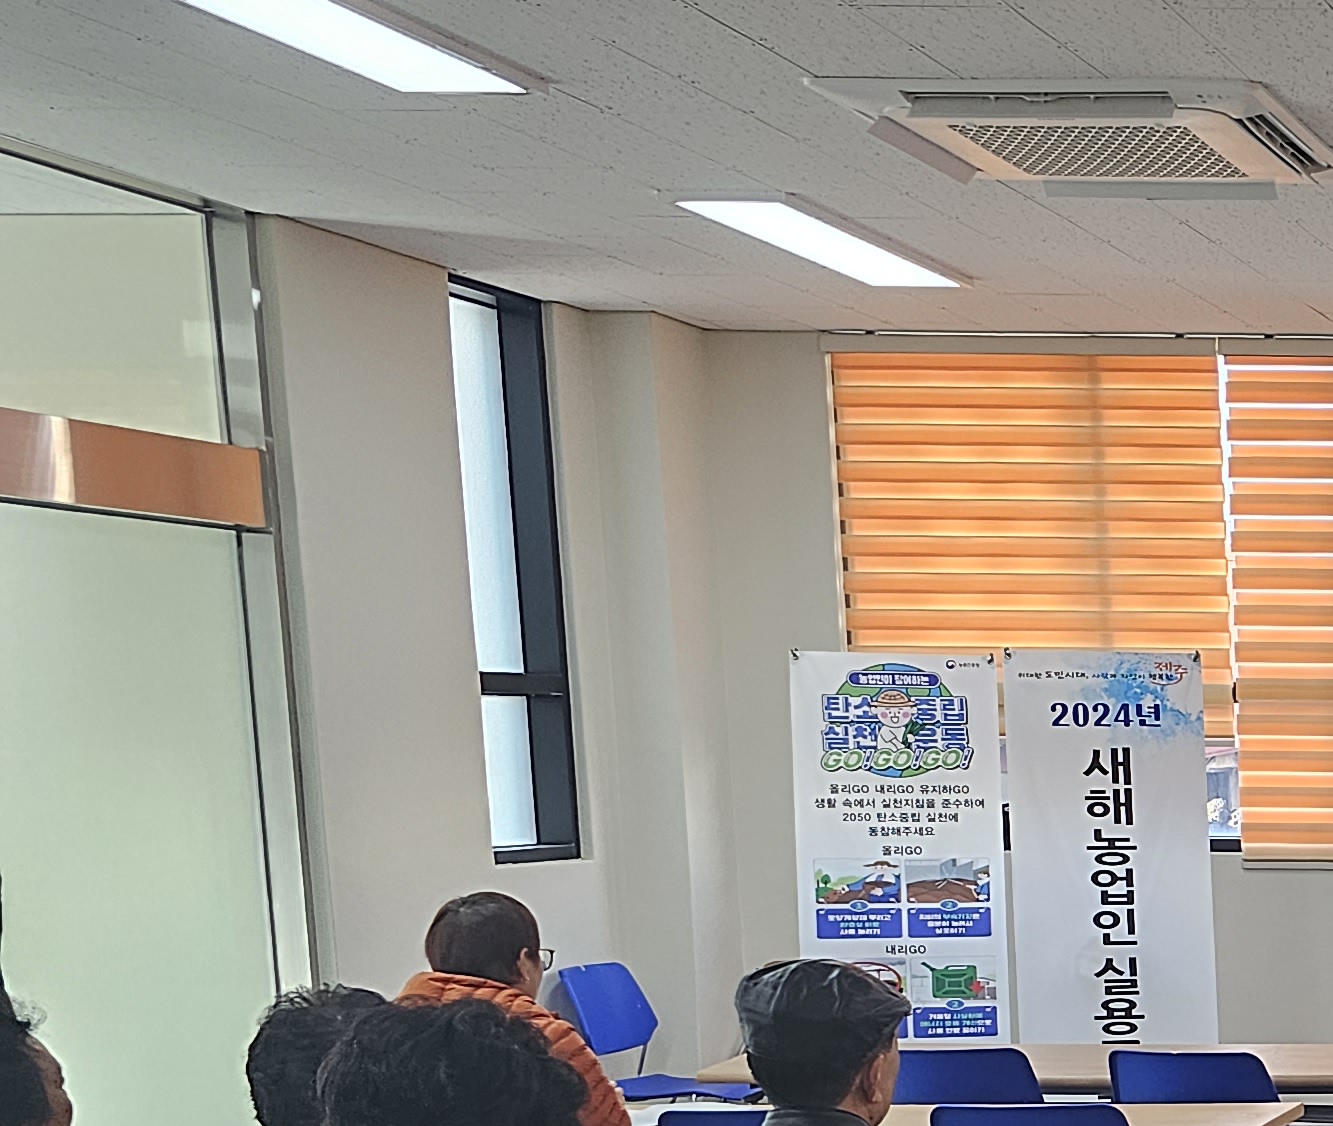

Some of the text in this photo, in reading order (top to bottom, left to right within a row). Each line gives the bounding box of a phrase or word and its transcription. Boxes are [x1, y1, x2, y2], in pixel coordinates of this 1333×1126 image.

[824, 696, 967, 722] 탄소 중립
[1050, 702, 1162, 728] 2024년
[824, 725, 878, 752] 실천
[829, 784, 970, 795] 올리GO 내리GO 유지하GO
[841, 798, 876, 809] 속에서
[880, 798, 936, 809] 실천지침을
[941, 798, 985, 809] 준수하여
[842, 812, 959, 823] 2050 탄소중립 실천에
[867, 826, 936, 837] 동참해주세요
[881, 845, 923, 856] 올리GO
[1082, 745, 1147, 1046] 새해농업인 실용
[886, 944, 927, 955] 내리GO
